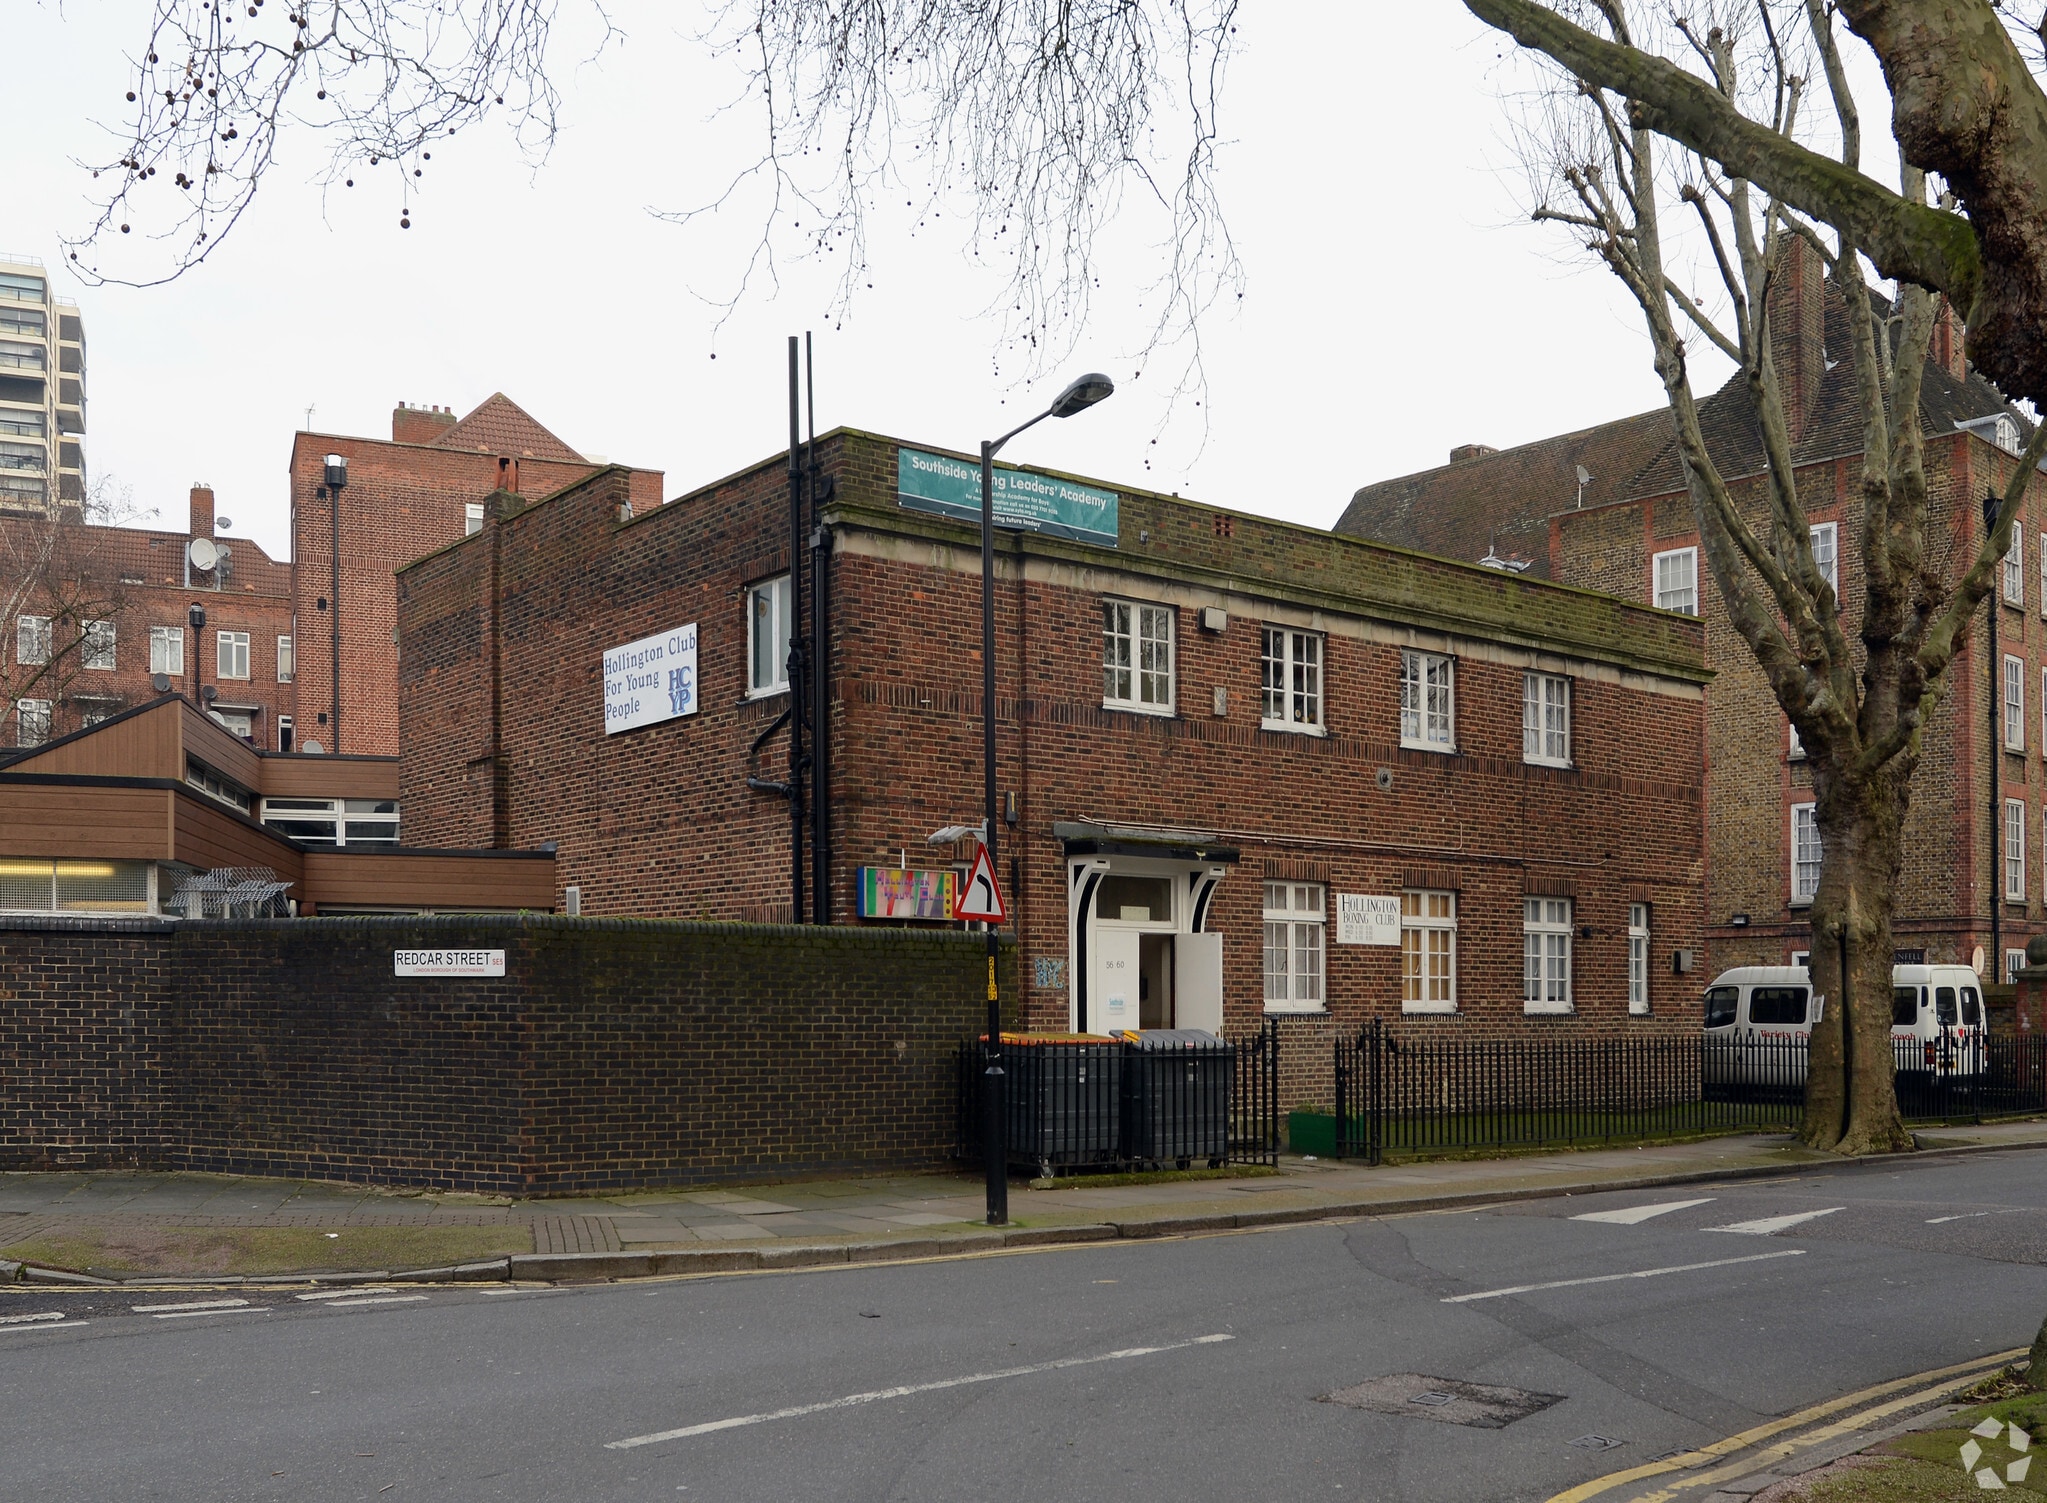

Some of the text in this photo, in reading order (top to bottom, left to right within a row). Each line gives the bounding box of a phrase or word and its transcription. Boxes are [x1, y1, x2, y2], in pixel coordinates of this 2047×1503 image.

[912, 456, 967, 480] Southside
[970, 469, 1006, 490] Yong
[1059, 487, 1106, 511] Academy
[1006, 516, 1022, 525] future
[605, 632, 696, 676] Hollington Club
[605, 671, 659, 697] For Young
[606, 697, 640, 720] People
[1342, 894, 1397, 913] HOLLINGTON
[1343, 912, 1395, 926] BOXING CLUB
[396, 952, 503, 966] REDCAR STREET SE5
[1760, 1029, 1791, 1040] Variety
